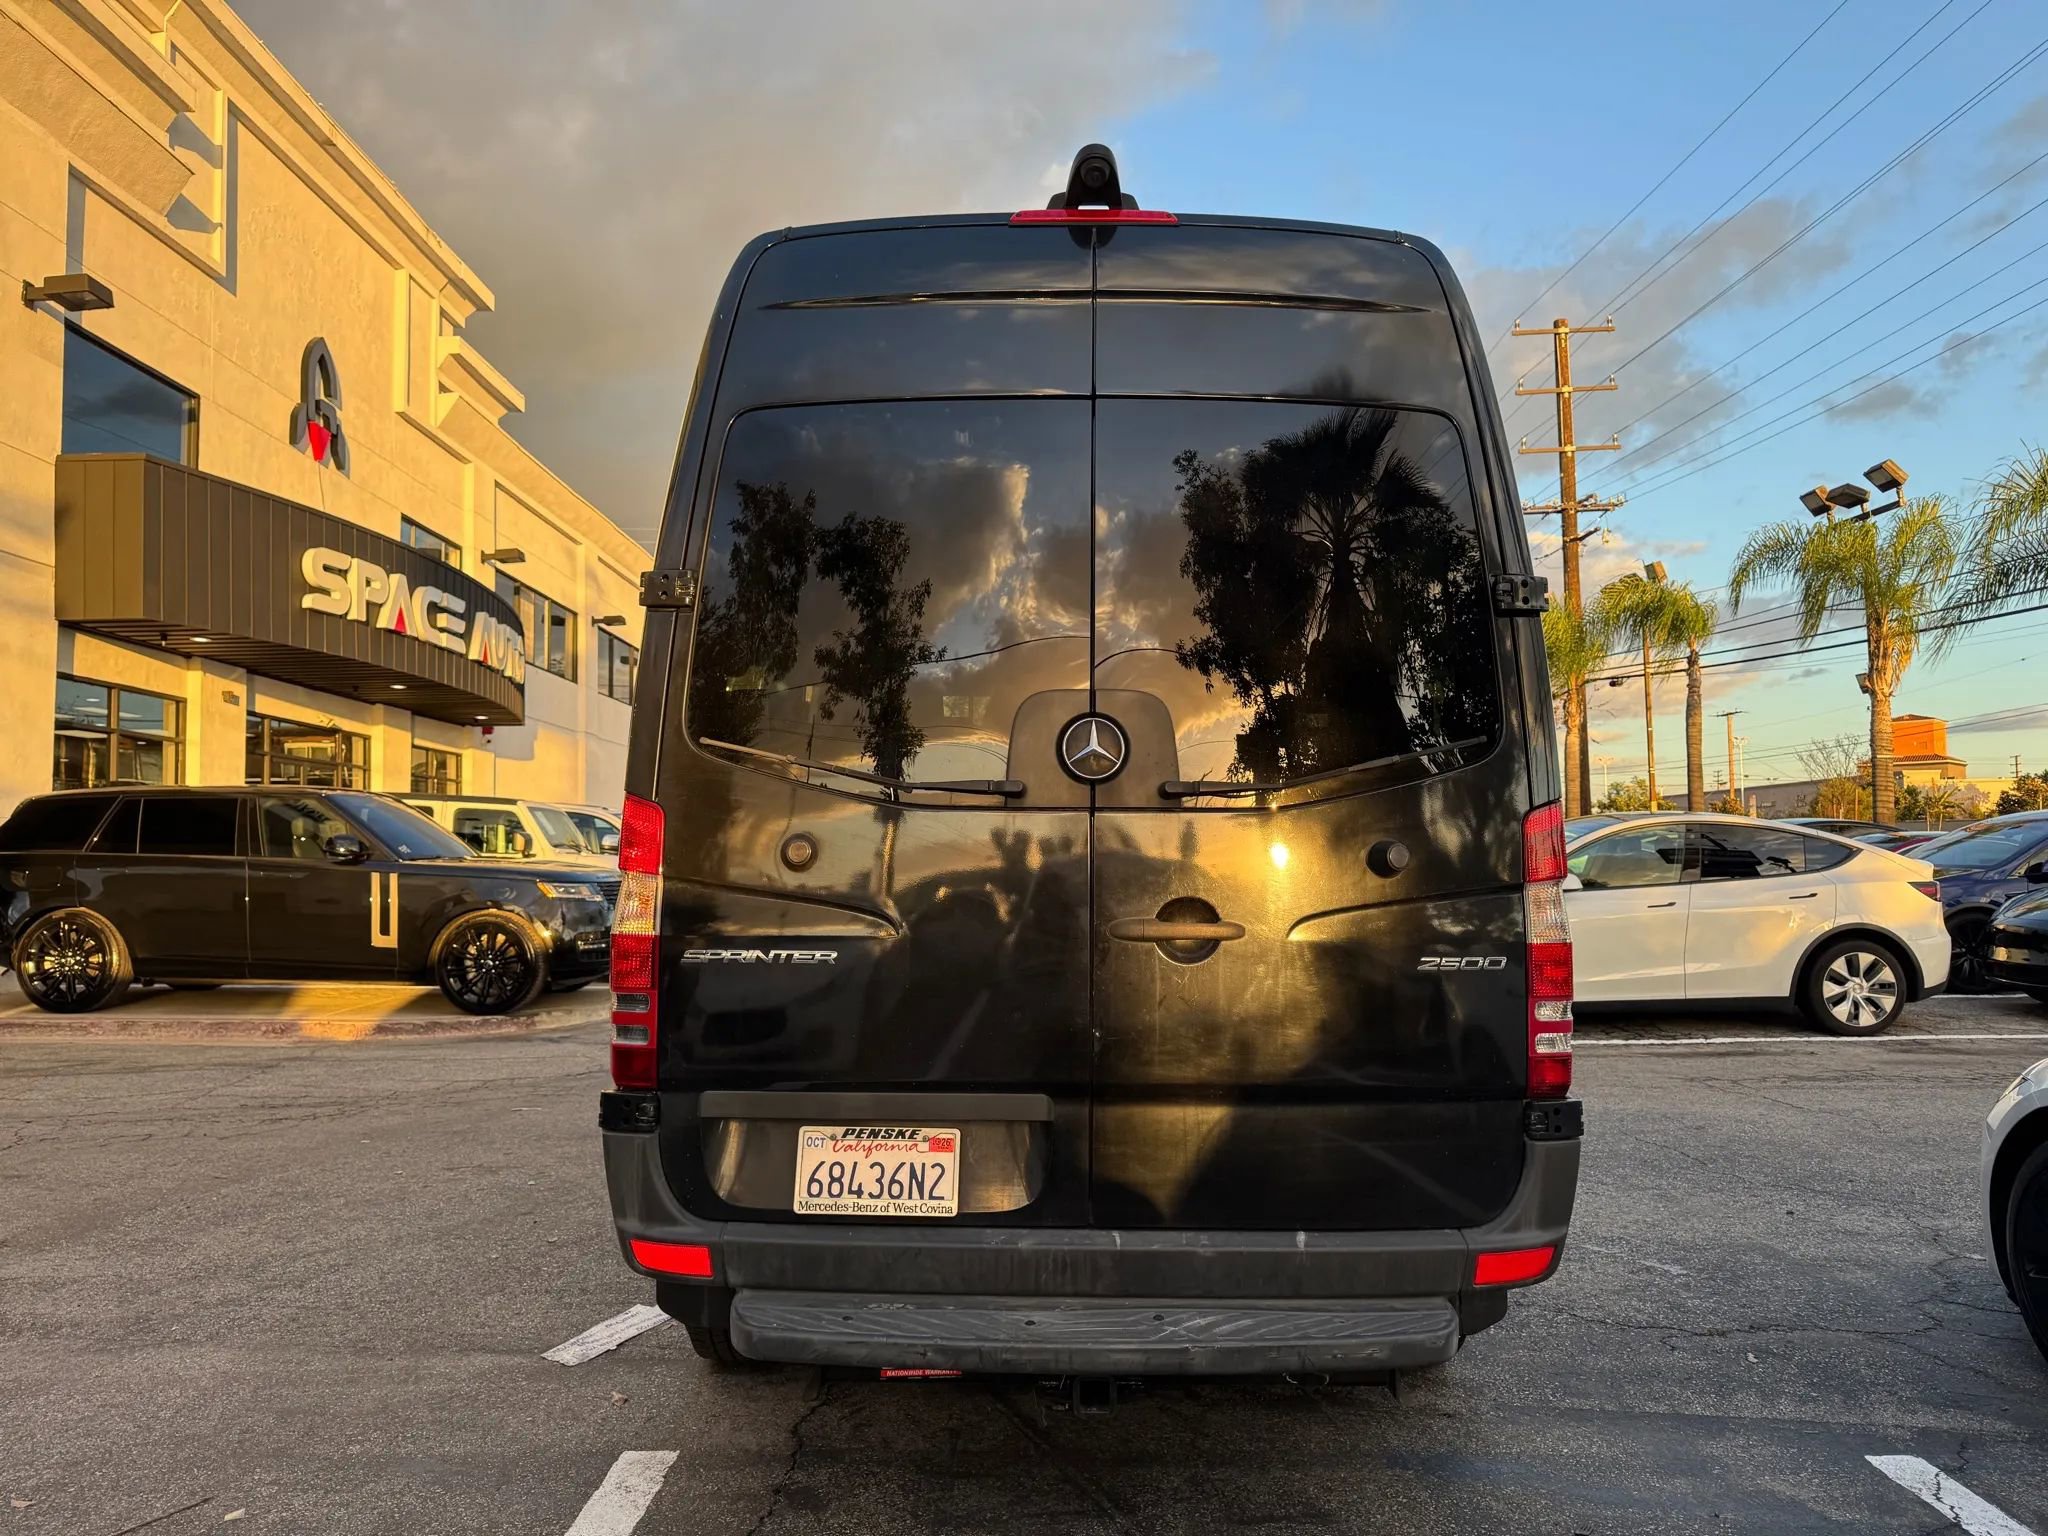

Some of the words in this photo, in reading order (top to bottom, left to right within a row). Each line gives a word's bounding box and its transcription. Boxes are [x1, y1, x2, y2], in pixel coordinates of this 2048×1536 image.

[302, 547, 466, 655] SPACE
[681, 949, 838, 965] SPRINTER
[1417, 956, 1508, 971] 2500
[841, 1128, 922, 1140] PENSKE
[806, 1136, 826, 1149] OCT
[832, 1139, 920, 1159] California
[806, 1160, 946, 1201] 68436N2
[798, 1201, 877, 1213] Mercedes-Benz
[880, 1202, 891, 1213] of
[892, 1203, 919, 1214] West
[919, 1203, 953, 1215] Covina
